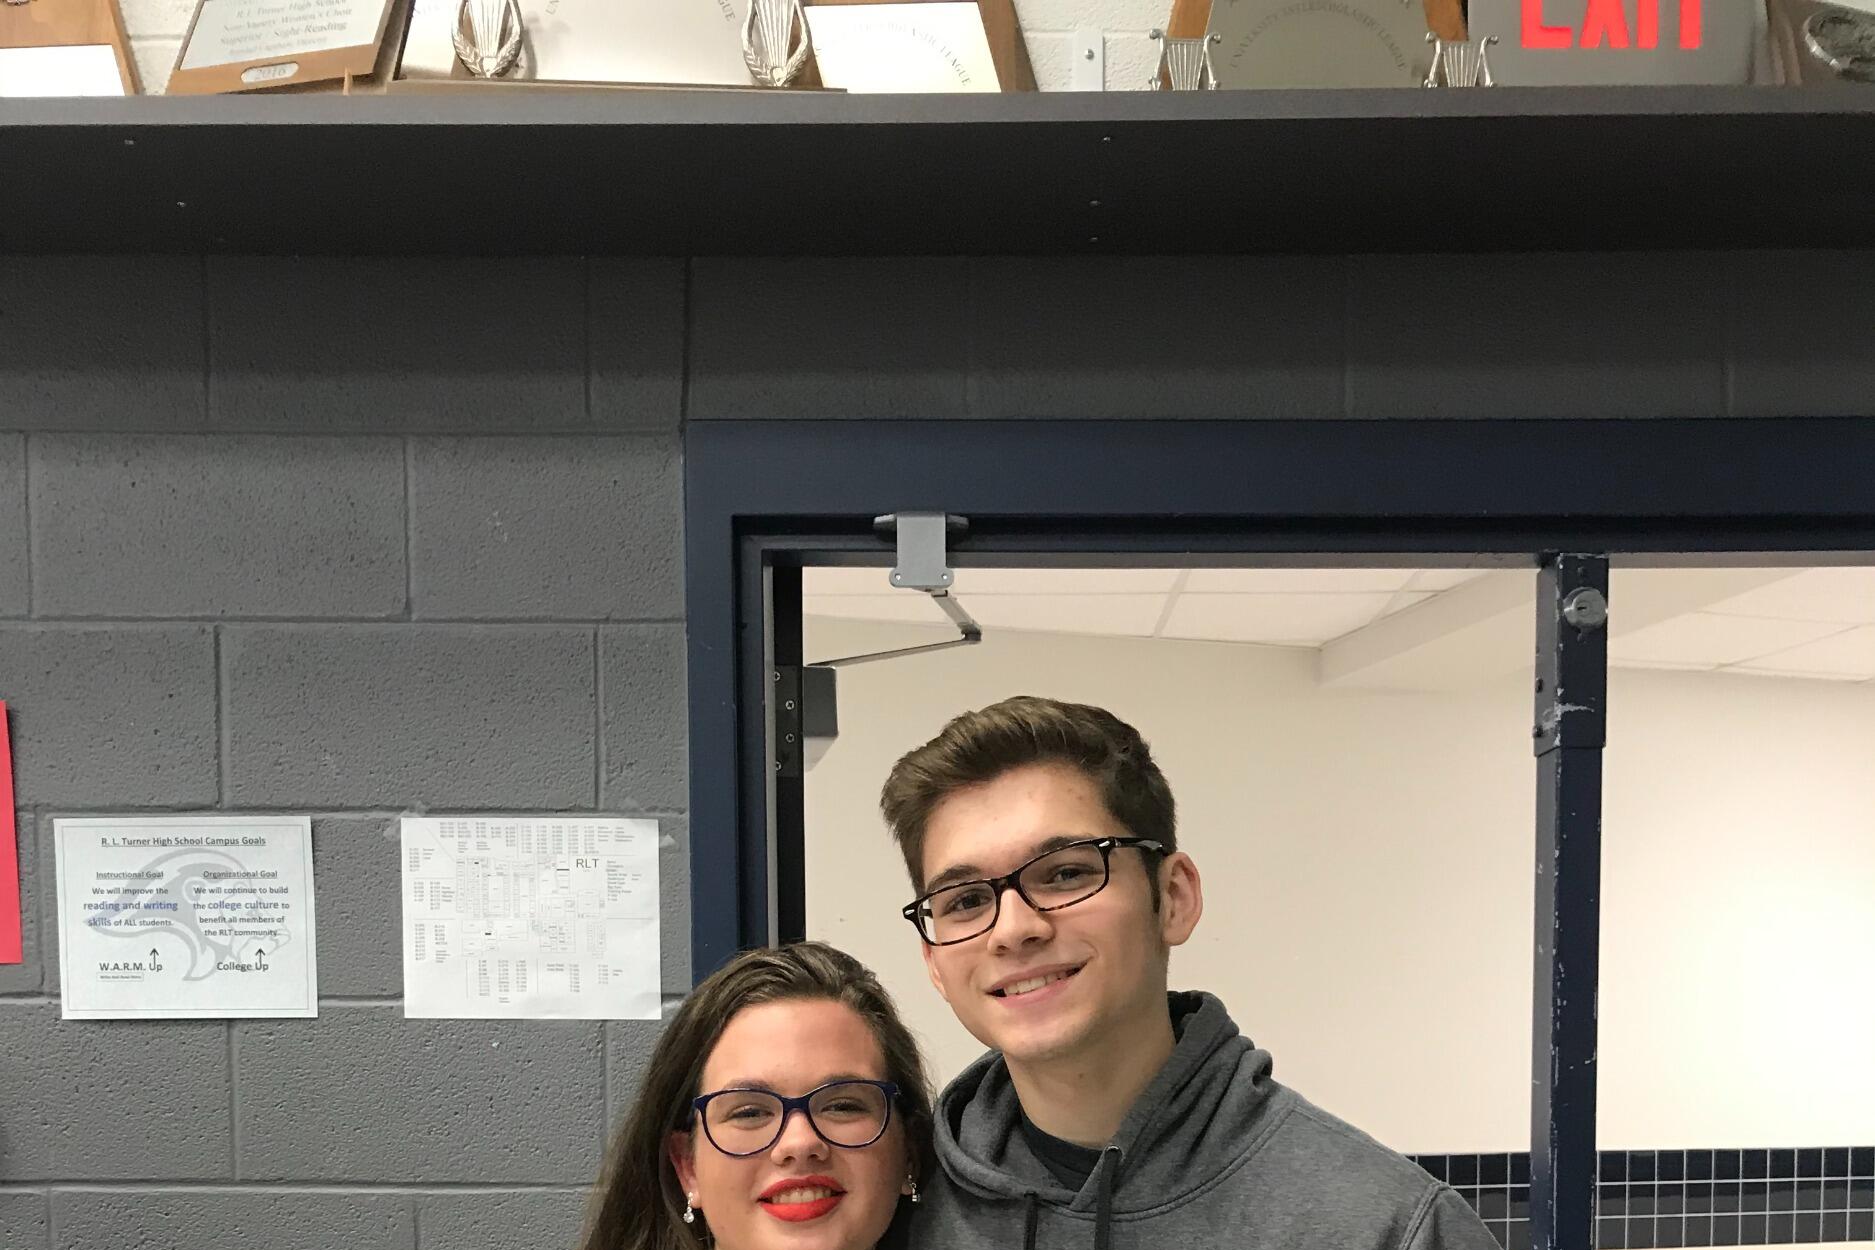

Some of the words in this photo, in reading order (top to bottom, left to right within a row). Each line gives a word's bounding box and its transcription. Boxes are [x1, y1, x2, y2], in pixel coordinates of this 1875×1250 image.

[121, 837, 151, 846] Turner
[153, 836, 173, 847] High
[174, 836, 204, 846] School
[205, 837, 240, 847] Campus
[241, 836, 267, 846] Goals
[576, 858, 600, 869] RLT
[96, 871, 144, 879] Instructional
[145, 871, 164, 879] Goal
[203, 870, 258, 879] Organizational
[260, 870, 278, 878] Goal
[92, 887, 105, 895] We
[107, 887, 120, 895] will
[122, 887, 154, 896] improve
[156, 887, 169, 895] the
[208, 886, 222, 894] will
[223, 886, 257, 894] continue
[269, 886, 289, 894] build
[83, 901, 120, 912] reading
[122, 901, 141, 910] and
[143, 901, 178, 912] writing
[193, 902, 206, 910] the
[207, 900, 242, 911] college
[244, 900, 279, 909] culture
[87, 917, 112, 927] skills
[113, 918, 123, 926] of
[199, 916, 226, 924] benefit
[219, 928, 233, 936] RLT
[99, 962, 146, 971] W.A.R.M.
[216, 962, 252, 973] College
